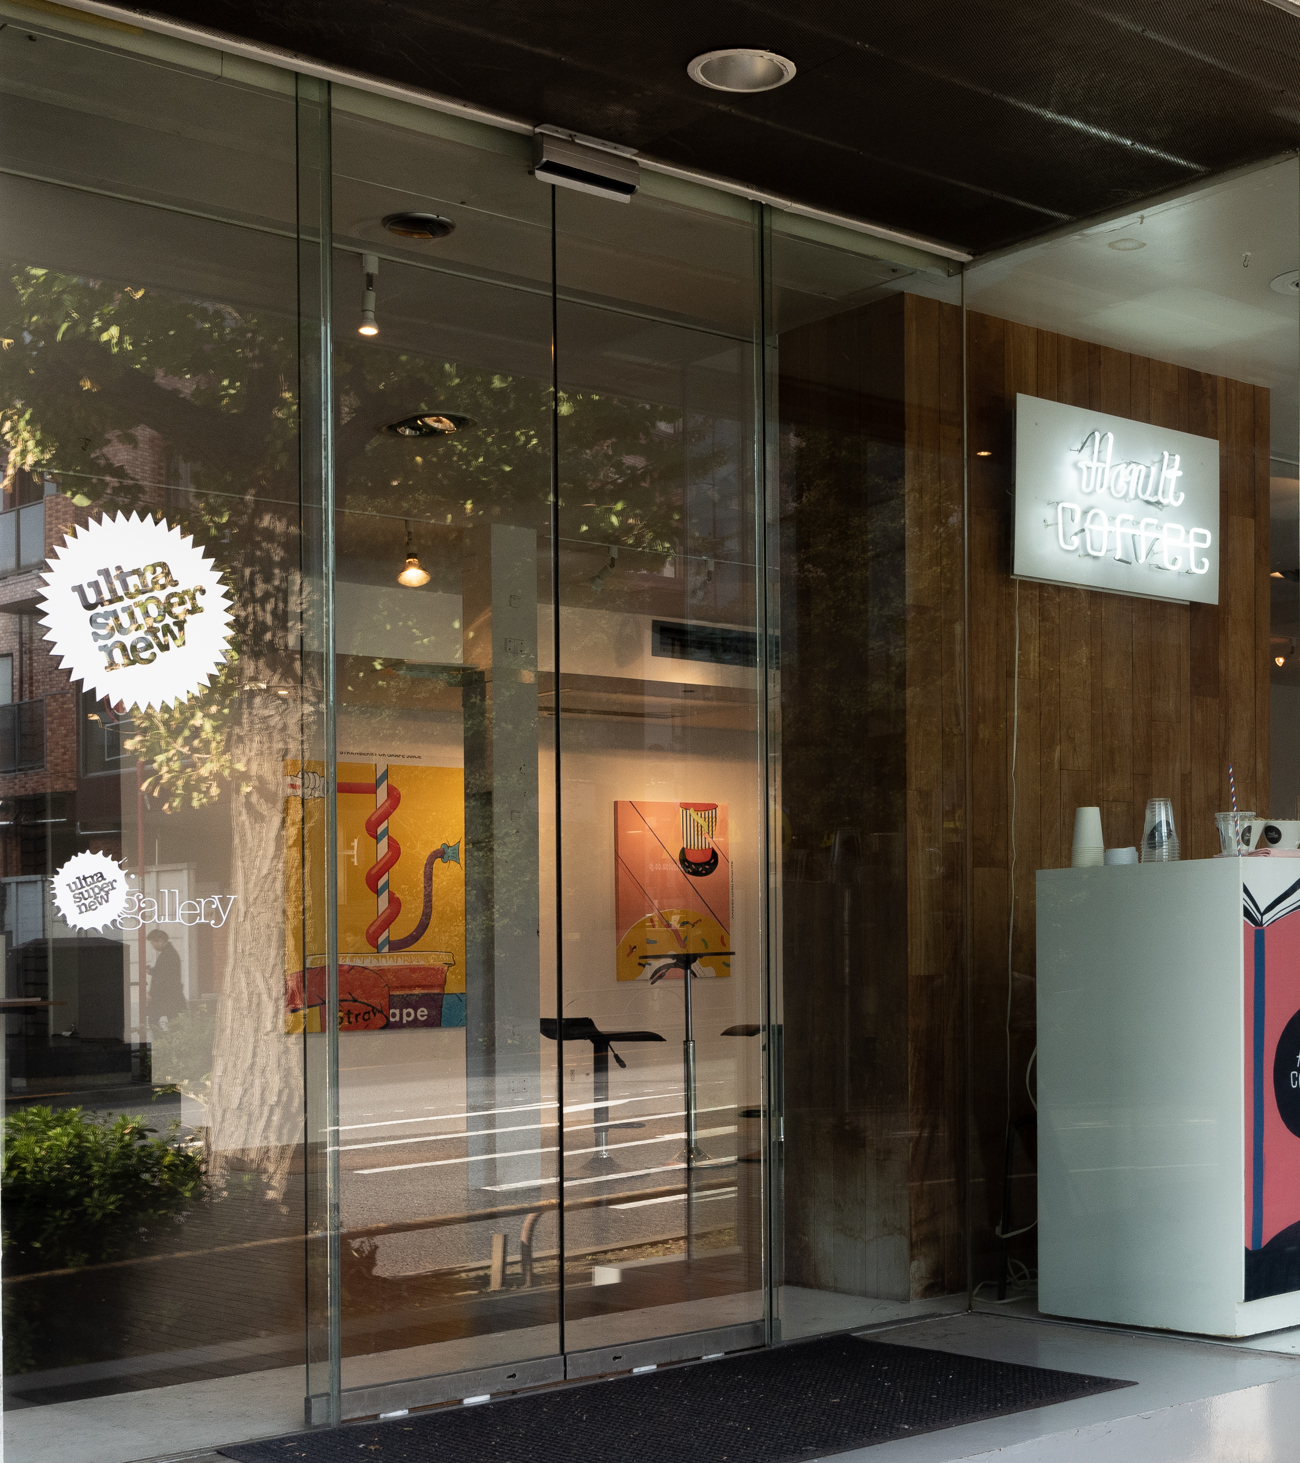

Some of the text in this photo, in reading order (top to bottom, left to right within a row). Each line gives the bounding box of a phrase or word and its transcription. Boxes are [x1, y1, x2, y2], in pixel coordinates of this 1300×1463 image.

[71, 561, 179, 611] ultra
[89, 585, 206, 643] super
[98, 619, 187, 672] new
[66, 871, 107, 893] ultra
[72, 879, 117, 904] super
[76, 891, 110, 915] new
[117, 889, 238, 931] gallery
